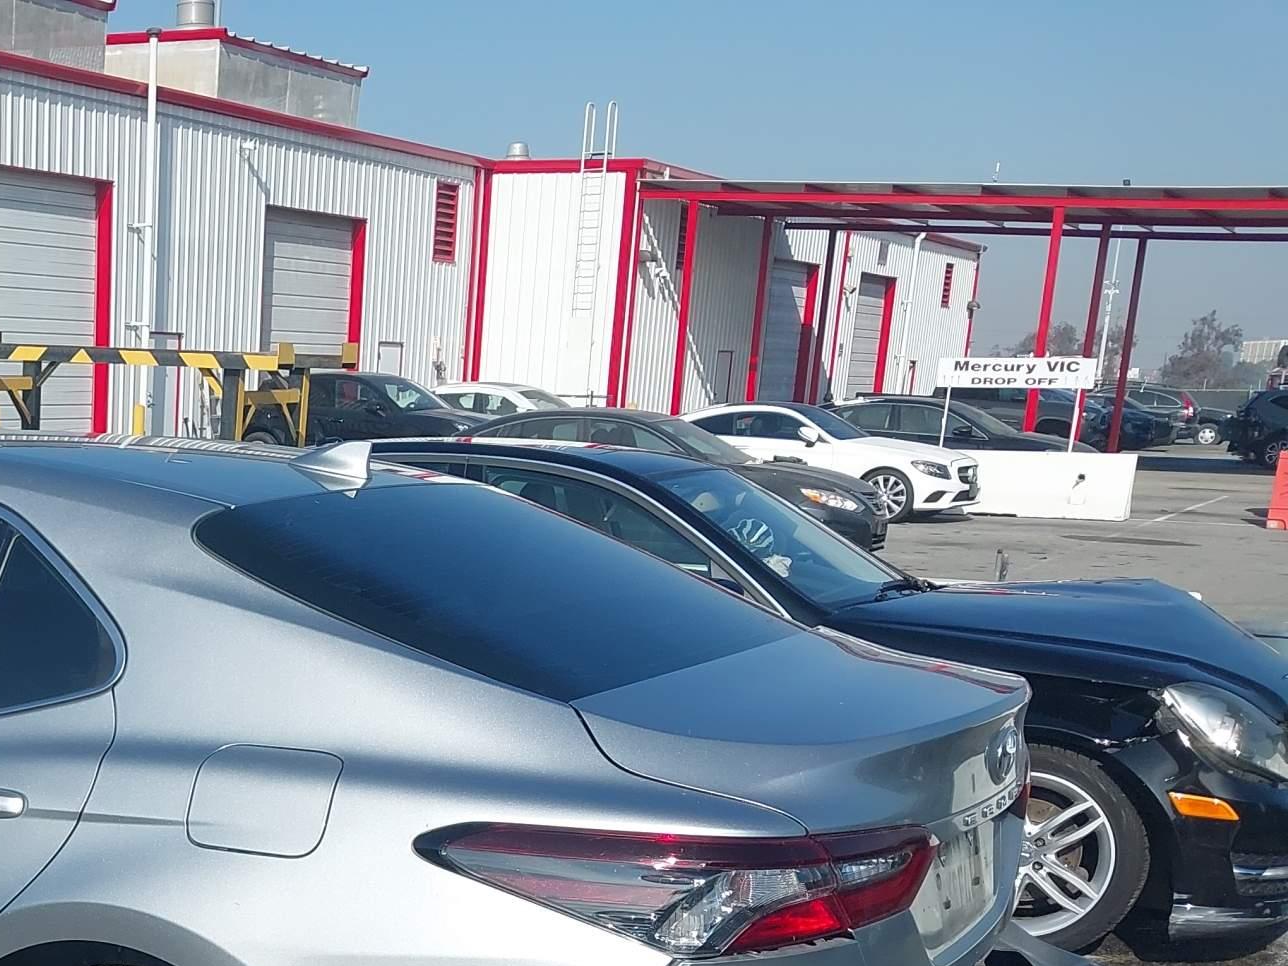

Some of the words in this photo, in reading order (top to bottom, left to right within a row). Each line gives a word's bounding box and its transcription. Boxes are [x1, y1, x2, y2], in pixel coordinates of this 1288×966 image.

[954, 360, 1037, 375] Mercury
[1046, 360, 1081, 373] VIC
[970, 377, 1017, 386] DROP
[1024, 377, 1059, 386] OFF
